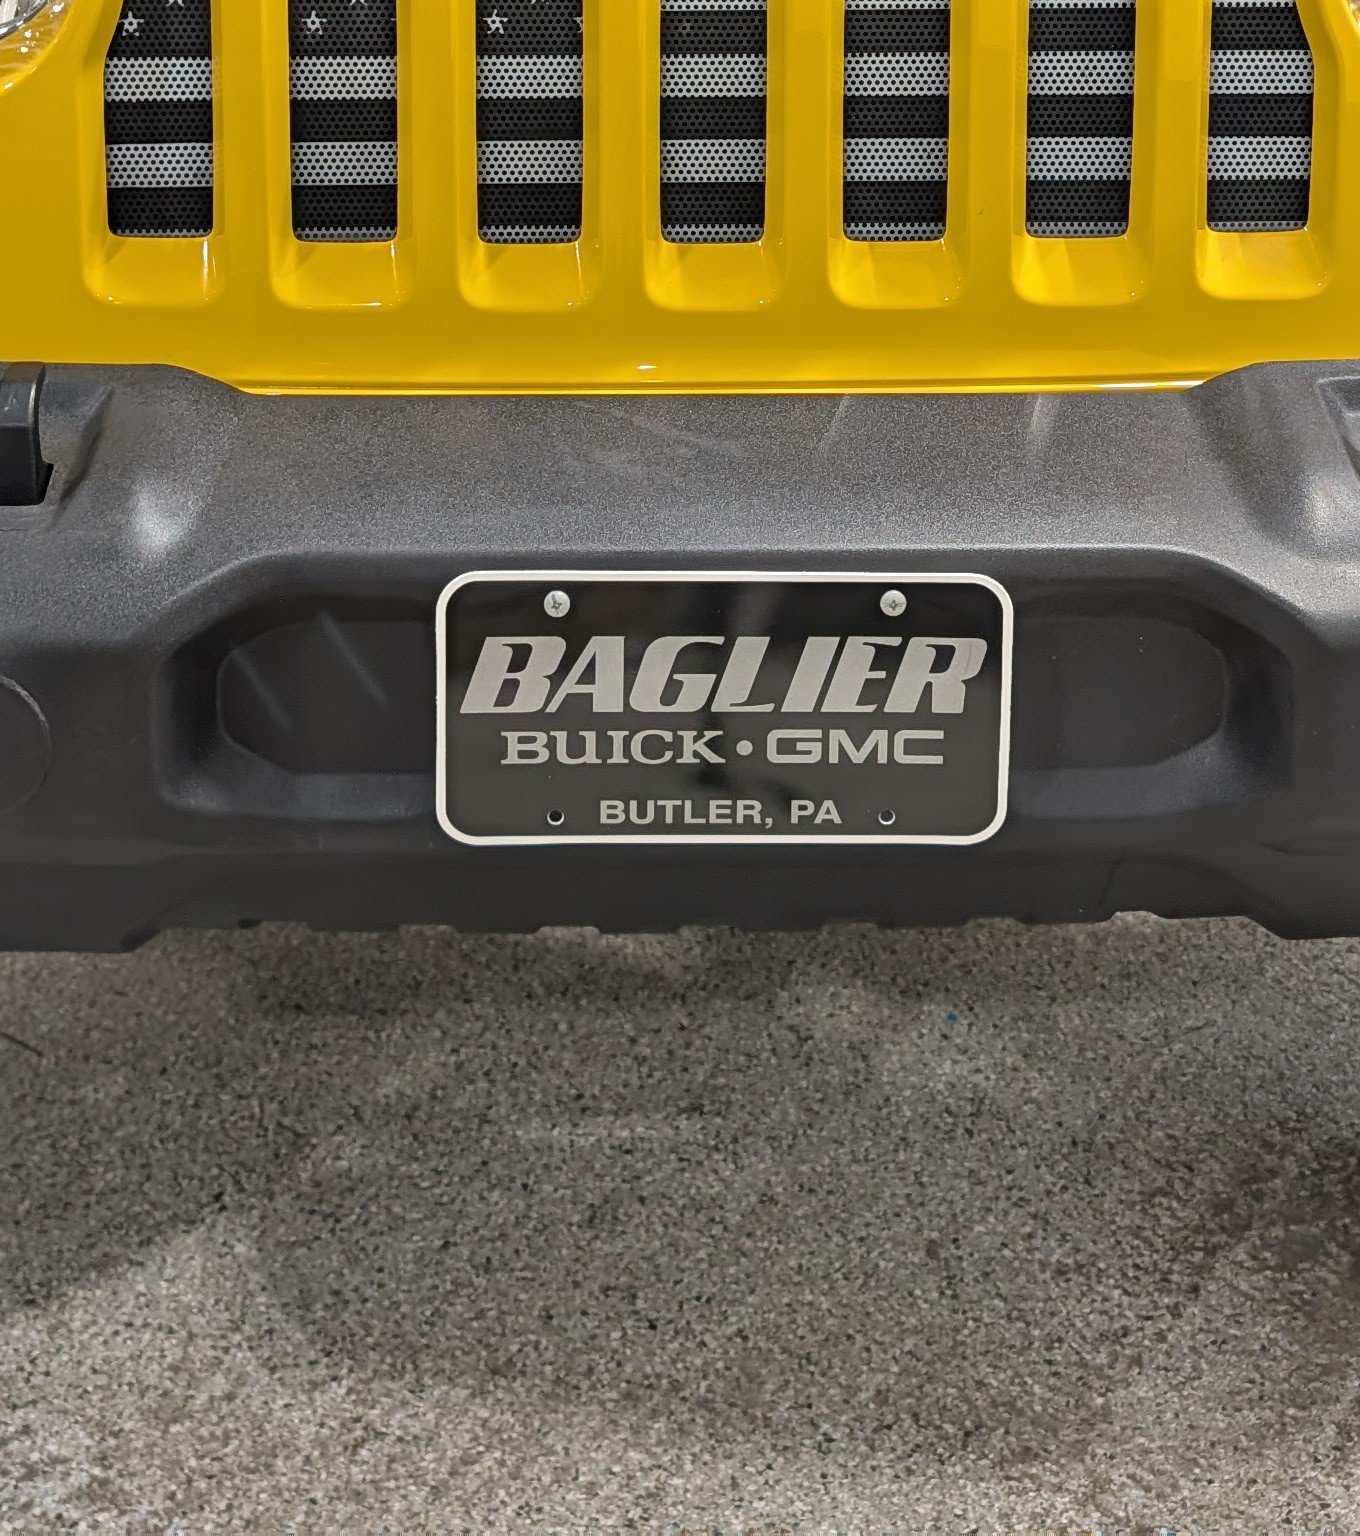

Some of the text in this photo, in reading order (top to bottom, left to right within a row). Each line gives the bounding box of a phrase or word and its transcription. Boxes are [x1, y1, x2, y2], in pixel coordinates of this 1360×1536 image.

[460, 636, 988, 714] BAGLIER
[501, 729, 945, 764] BUICK GMC
[600, 800, 843, 829] BUTLER, PA
